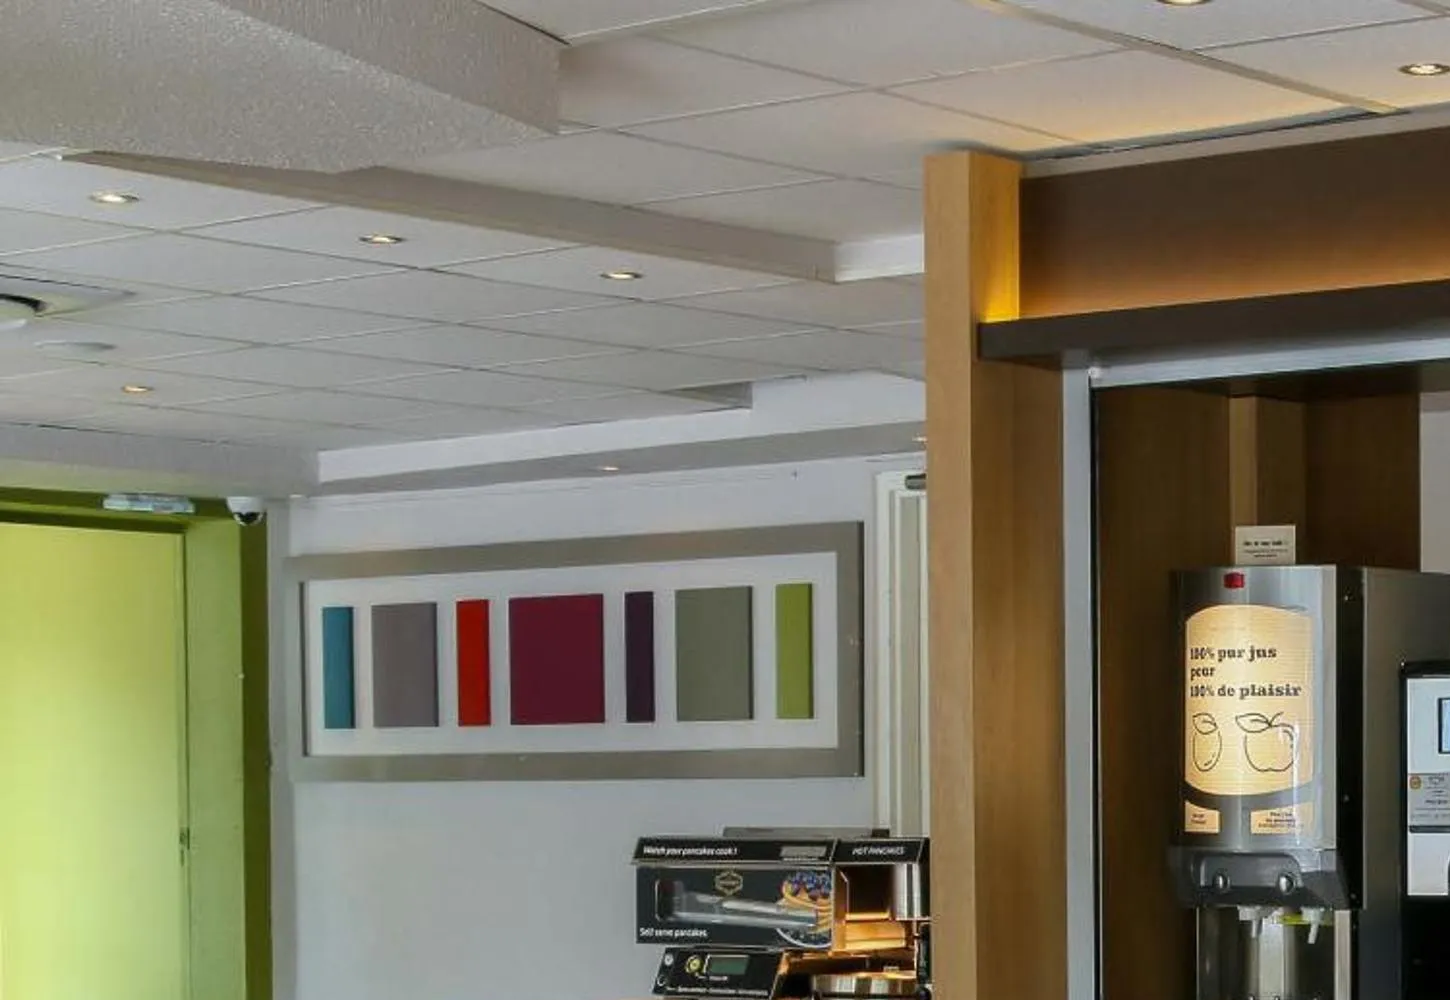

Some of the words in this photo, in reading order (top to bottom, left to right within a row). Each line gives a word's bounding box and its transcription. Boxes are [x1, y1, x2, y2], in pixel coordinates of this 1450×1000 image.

[1190, 647, 1215, 660] 100%
[1217, 648, 1246, 663] pur
[1247, 645, 1278, 662] jus
[1190, 684, 1215, 698] 100%
[1217, 683, 1236, 697] de
[1238, 683, 1302, 700] plaisir
